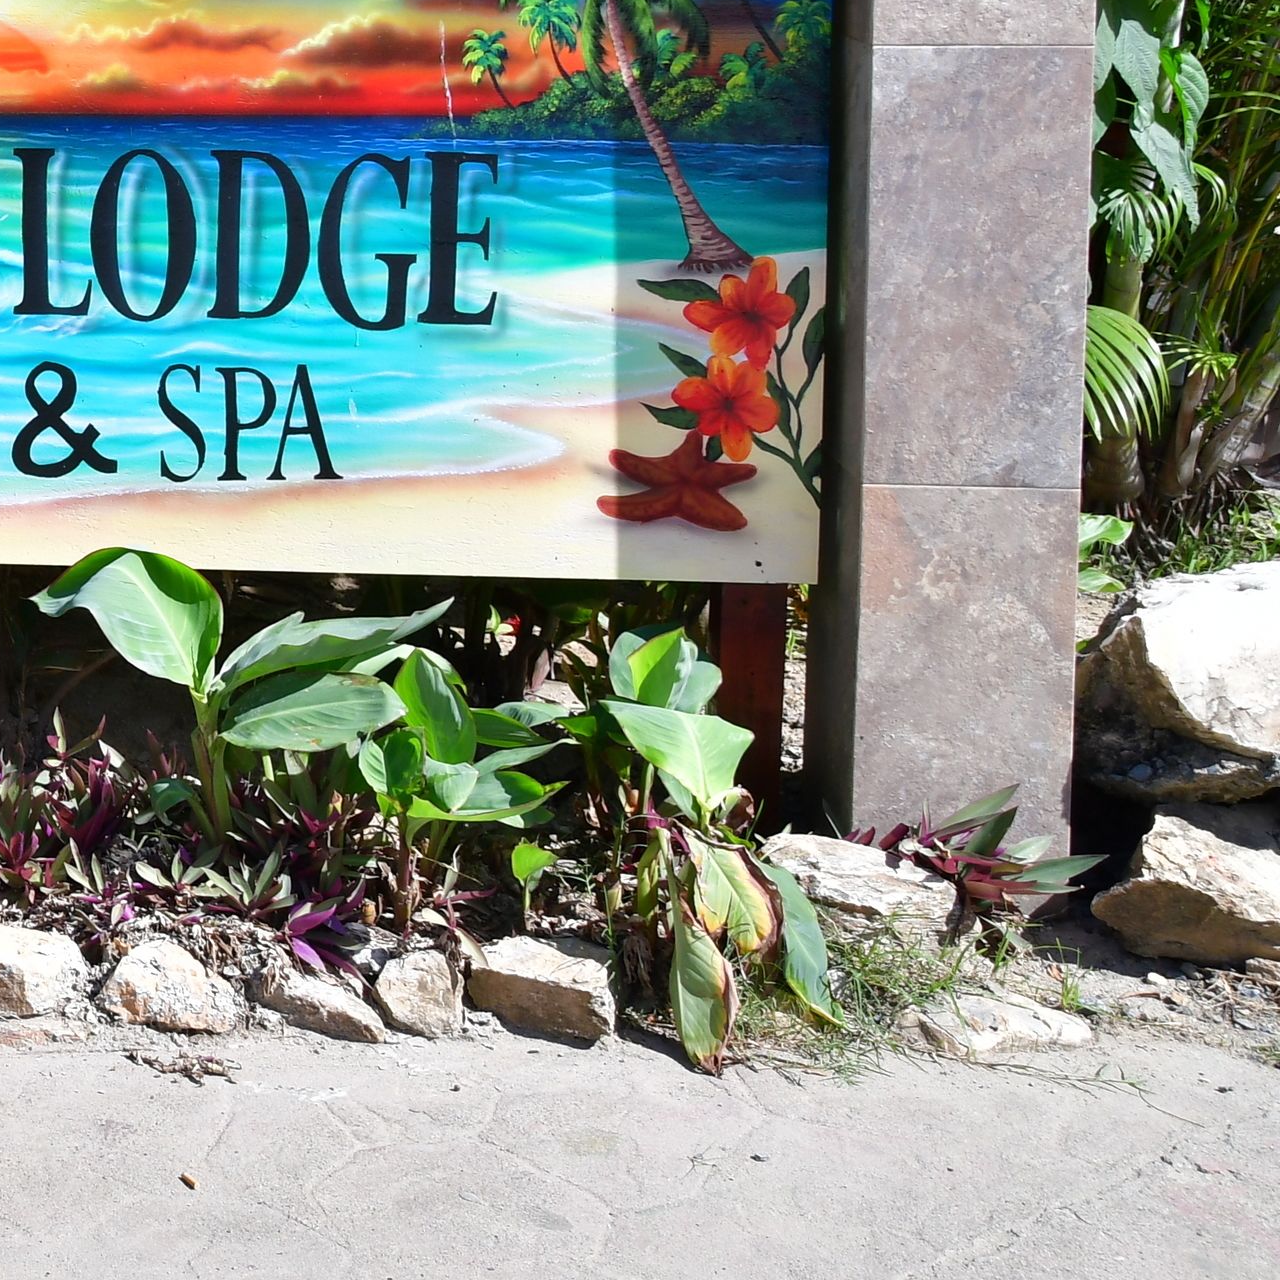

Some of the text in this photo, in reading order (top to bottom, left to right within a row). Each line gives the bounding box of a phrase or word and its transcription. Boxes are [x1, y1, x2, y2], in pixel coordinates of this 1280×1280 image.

[13, 147, 500, 331] LODGE
[10, 361, 118, 478] &
[158, 363, 344, 481] SPA
